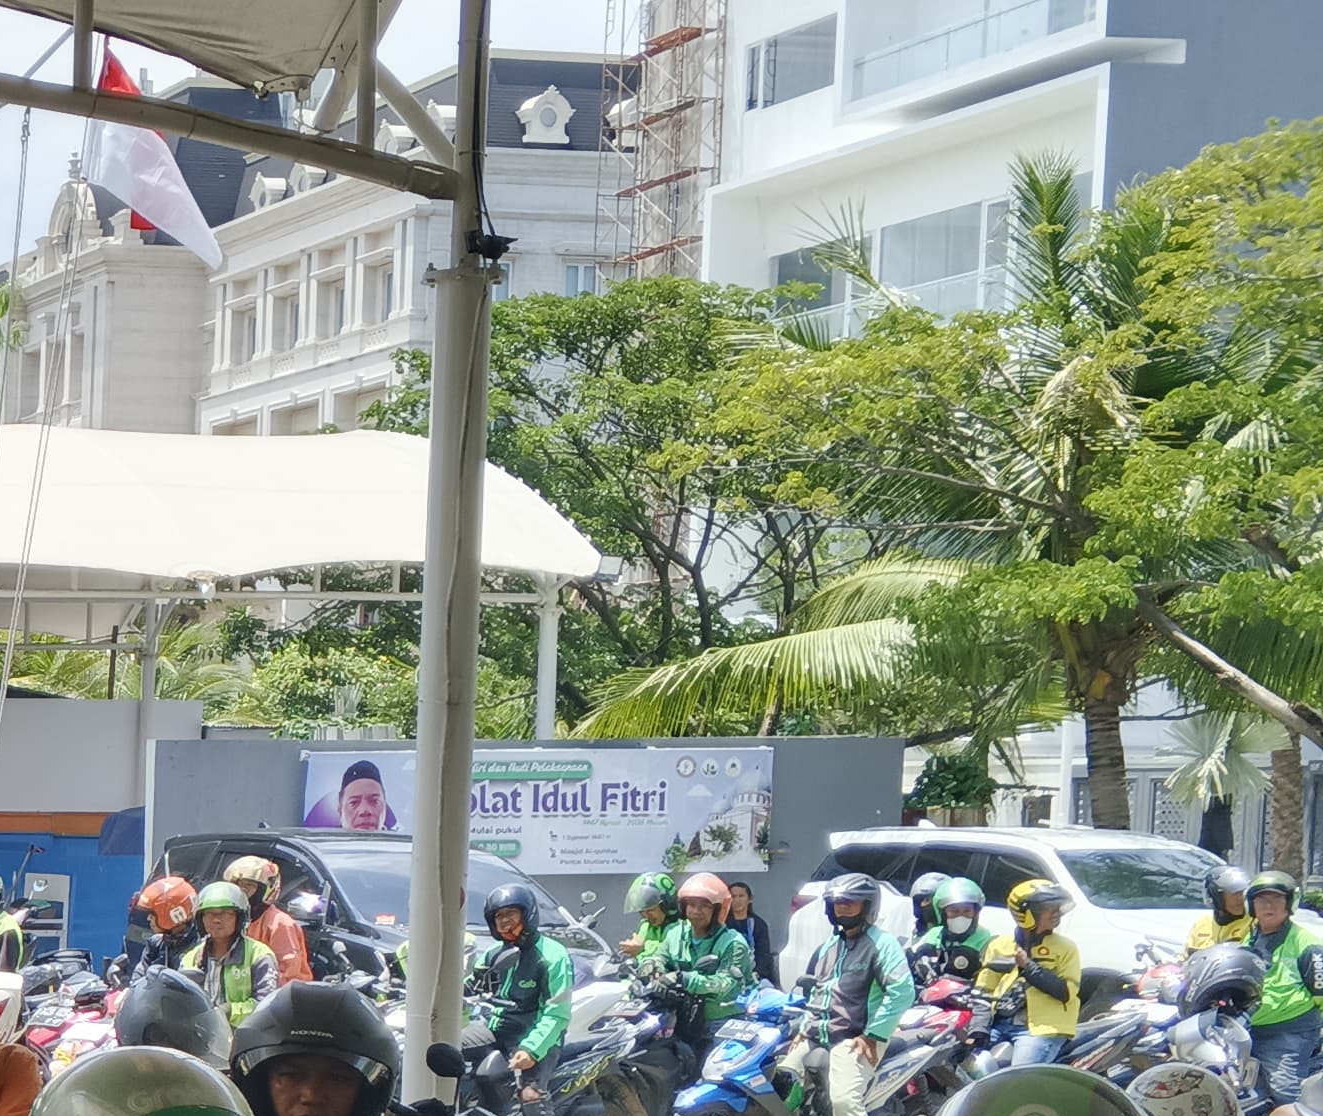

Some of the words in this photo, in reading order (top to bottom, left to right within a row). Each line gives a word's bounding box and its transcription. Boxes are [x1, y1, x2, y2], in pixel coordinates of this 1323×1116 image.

[471, 783, 522, 814] olat
[531, 780, 591, 813] Idul
[600, 780, 667, 813] Fitri
